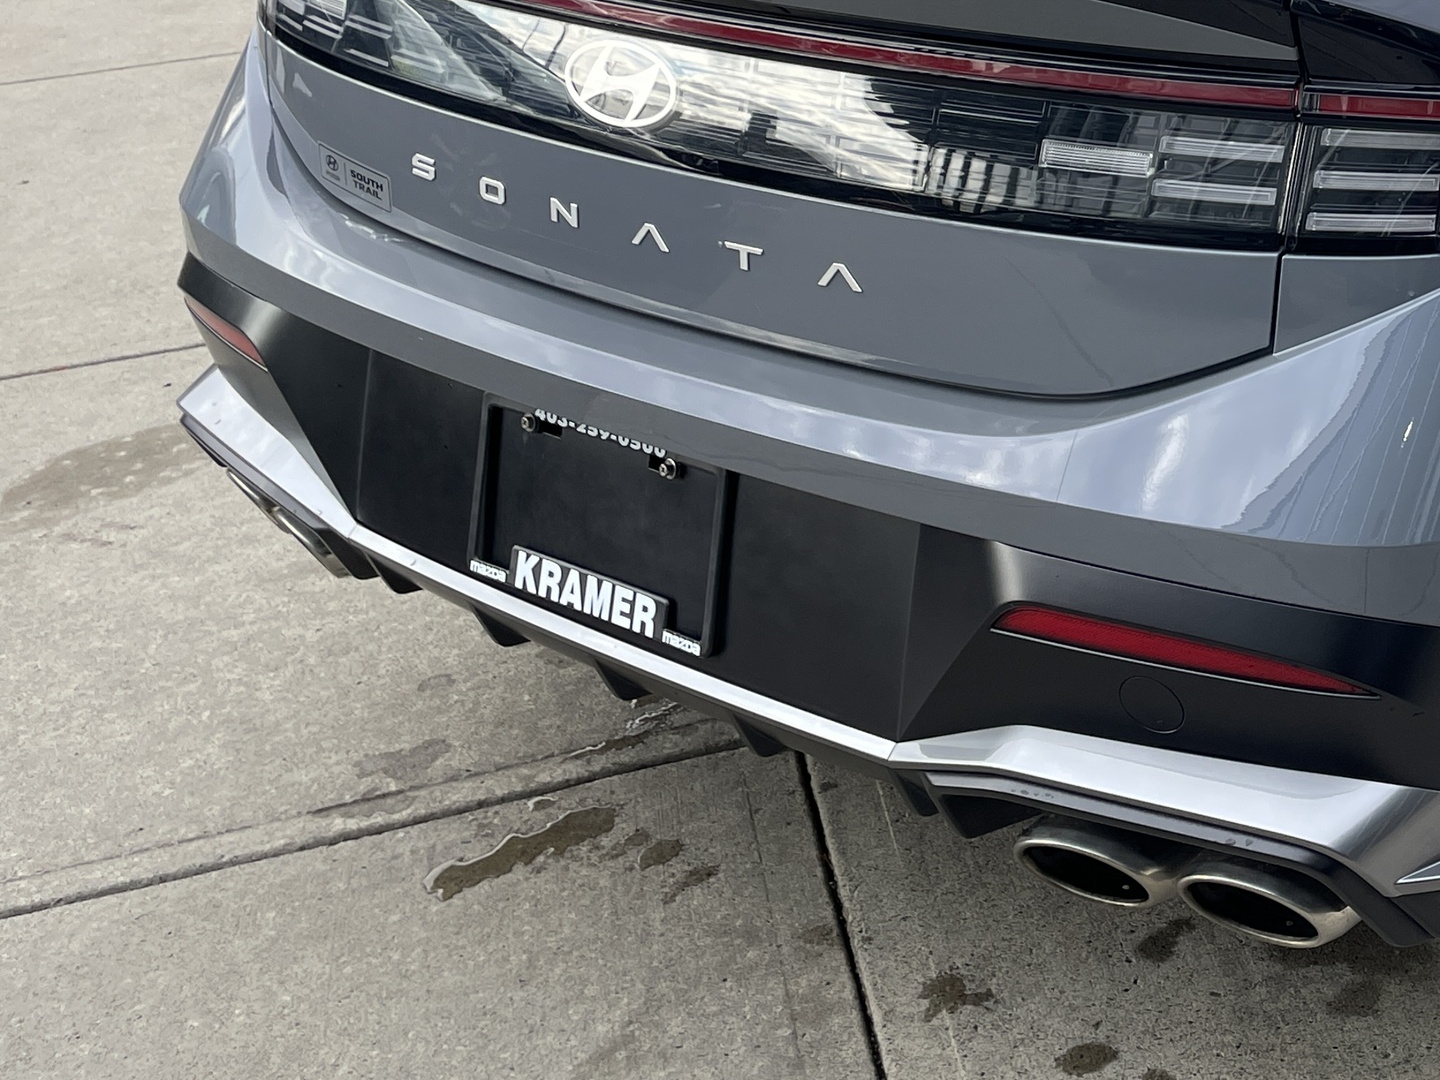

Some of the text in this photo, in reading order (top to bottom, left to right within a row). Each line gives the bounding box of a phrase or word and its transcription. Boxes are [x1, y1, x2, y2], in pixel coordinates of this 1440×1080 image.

[350, 169, 384, 192] SOUTH
[352, 179, 383, 201] TRAIL
[410, 152, 863, 294] SONATA
[514, 550, 658, 639] KRAMER
[661, 630, 701, 657] mazda
